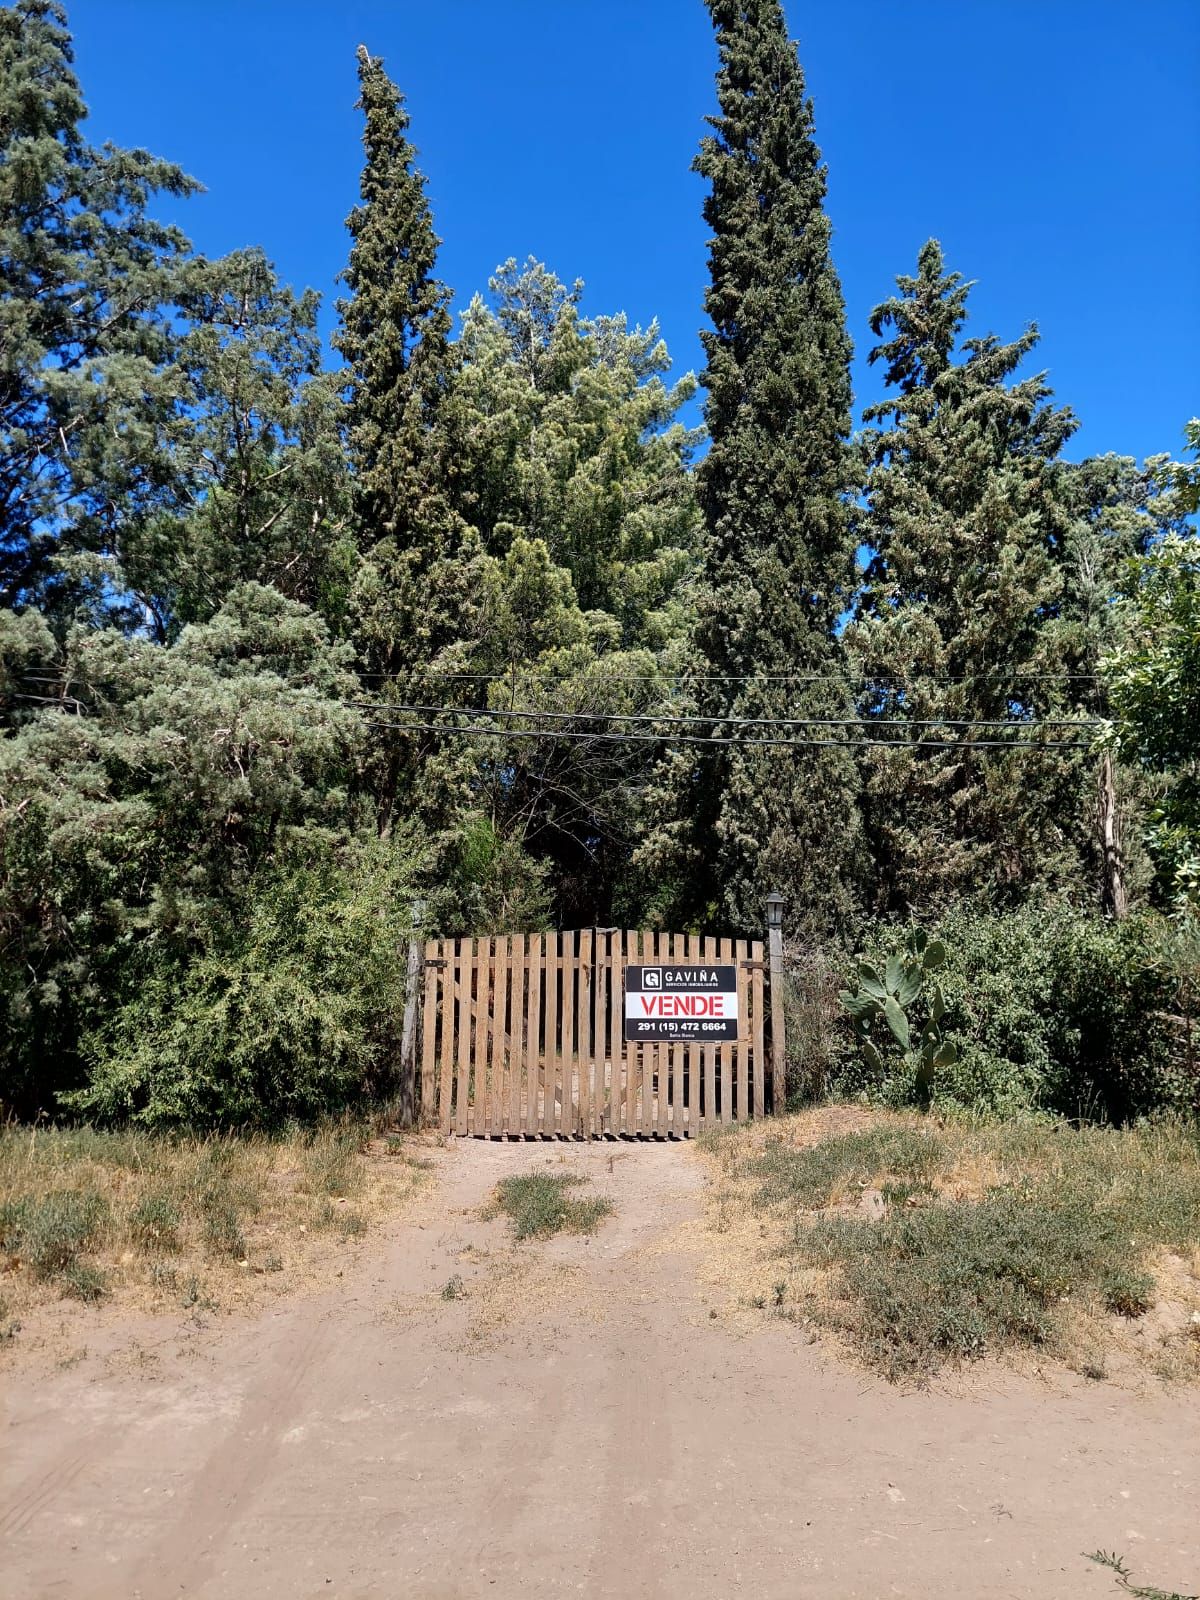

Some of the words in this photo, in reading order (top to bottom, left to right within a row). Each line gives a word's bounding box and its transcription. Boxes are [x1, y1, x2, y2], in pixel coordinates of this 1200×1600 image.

[665, 970, 719, 982] GAVIÑA
[640, 995, 724, 1016] VENDE
[637, 1022, 656, 1031] 291
[659, 1022, 678, 1032] (15)
[681, 1022, 699, 1031] 472
[702, 1022, 727, 1031] 6664
